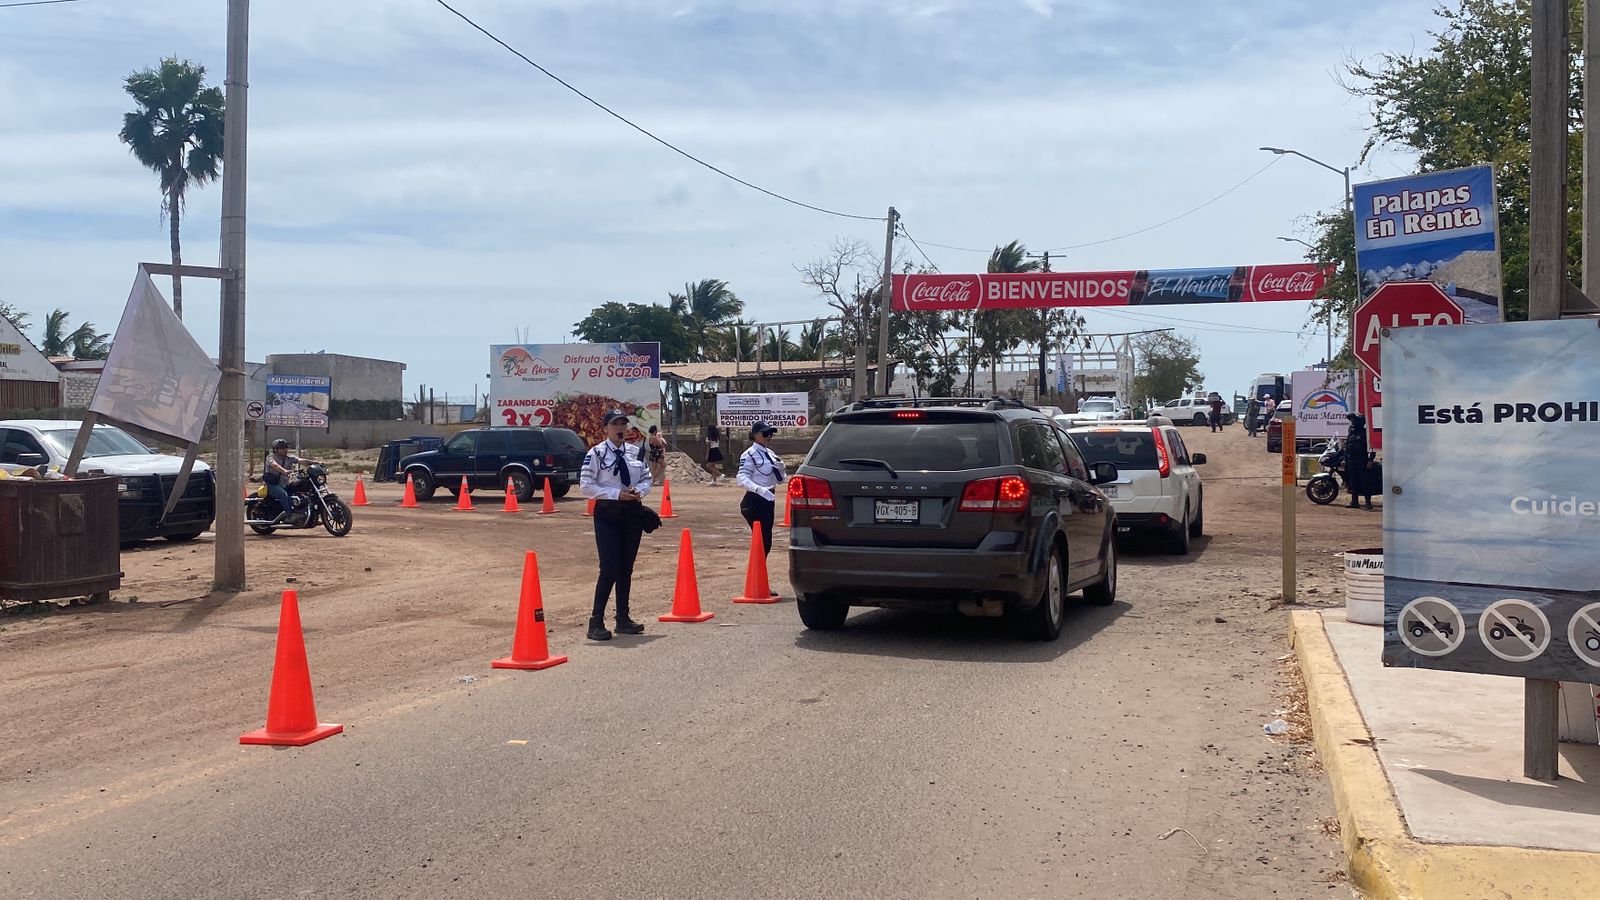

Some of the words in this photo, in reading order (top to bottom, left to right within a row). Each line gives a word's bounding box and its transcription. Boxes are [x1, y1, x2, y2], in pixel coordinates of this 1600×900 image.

[1373, 184, 1471, 216] Palapas
[1366, 218, 1395, 239] En
[1403, 207, 1481, 234] Renta
[911, 280, 974, 303] Coca-Cola
[988, 278, 1128, 300] BIENVENIDOS
[1147, 276, 1172, 297] El
[1257, 271, 1317, 294] Coca-Cola
[564, 354, 601, 364] Disfruta
[602, 354, 618, 364] del
[620, 353, 651, 364] Sabor
[514, 364, 528, 377] Las
[570, 367, 580, 380] y
[588, 365, 603, 378] el
[605, 363, 653, 378] Sazón
[497, 399, 554, 407] ZARANDEADO
[1296, 411, 1318, 423] Agua
[1320, 411, 1348, 420] Marin
[1418, 402, 1483, 424] Está
[1493, 401, 1600, 423] PROHI
[1510, 495, 1600, 516] Cuide
[1362, 558, 1384, 569] MAVI
